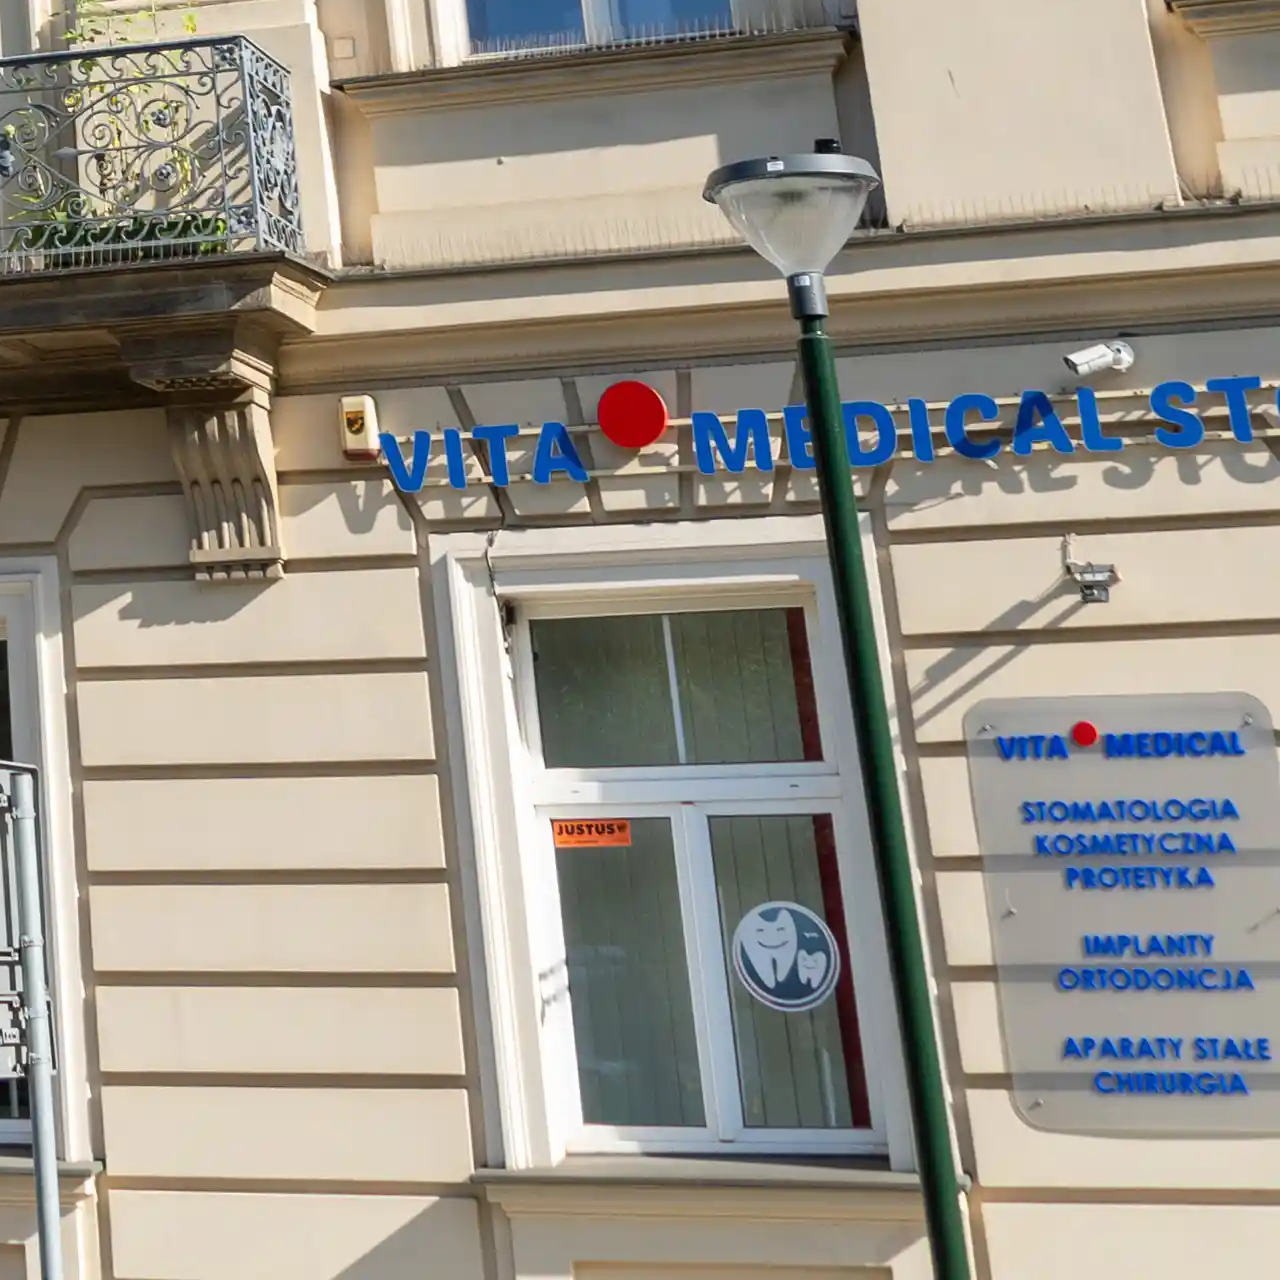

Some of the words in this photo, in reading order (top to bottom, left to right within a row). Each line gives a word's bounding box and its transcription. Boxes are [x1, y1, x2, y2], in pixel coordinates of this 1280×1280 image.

[378, 422, 590, 493] VITA
[691, 386, 1124, 476] MEDICAL
[1149, 375, 1280, 449] ST
[996, 735, 1069, 761] VITA
[1103, 731, 1246, 760] MEDICAL
[1020, 798, 1240, 824] STOMATOLOGIA
[557, 823, 615, 836] JUSTUS
[1035, 832, 1237, 856] KOSMETYCZNA
[1064, 866, 1215, 889] PROTETYKA
[1083, 934, 1215, 957] IMPLANTY
[1057, 967, 1255, 991] ORTODONCJA
[1062, 1037, 1183, 1060] APARATY
[1093, 1071, 1250, 1096] CHIRURGIA
